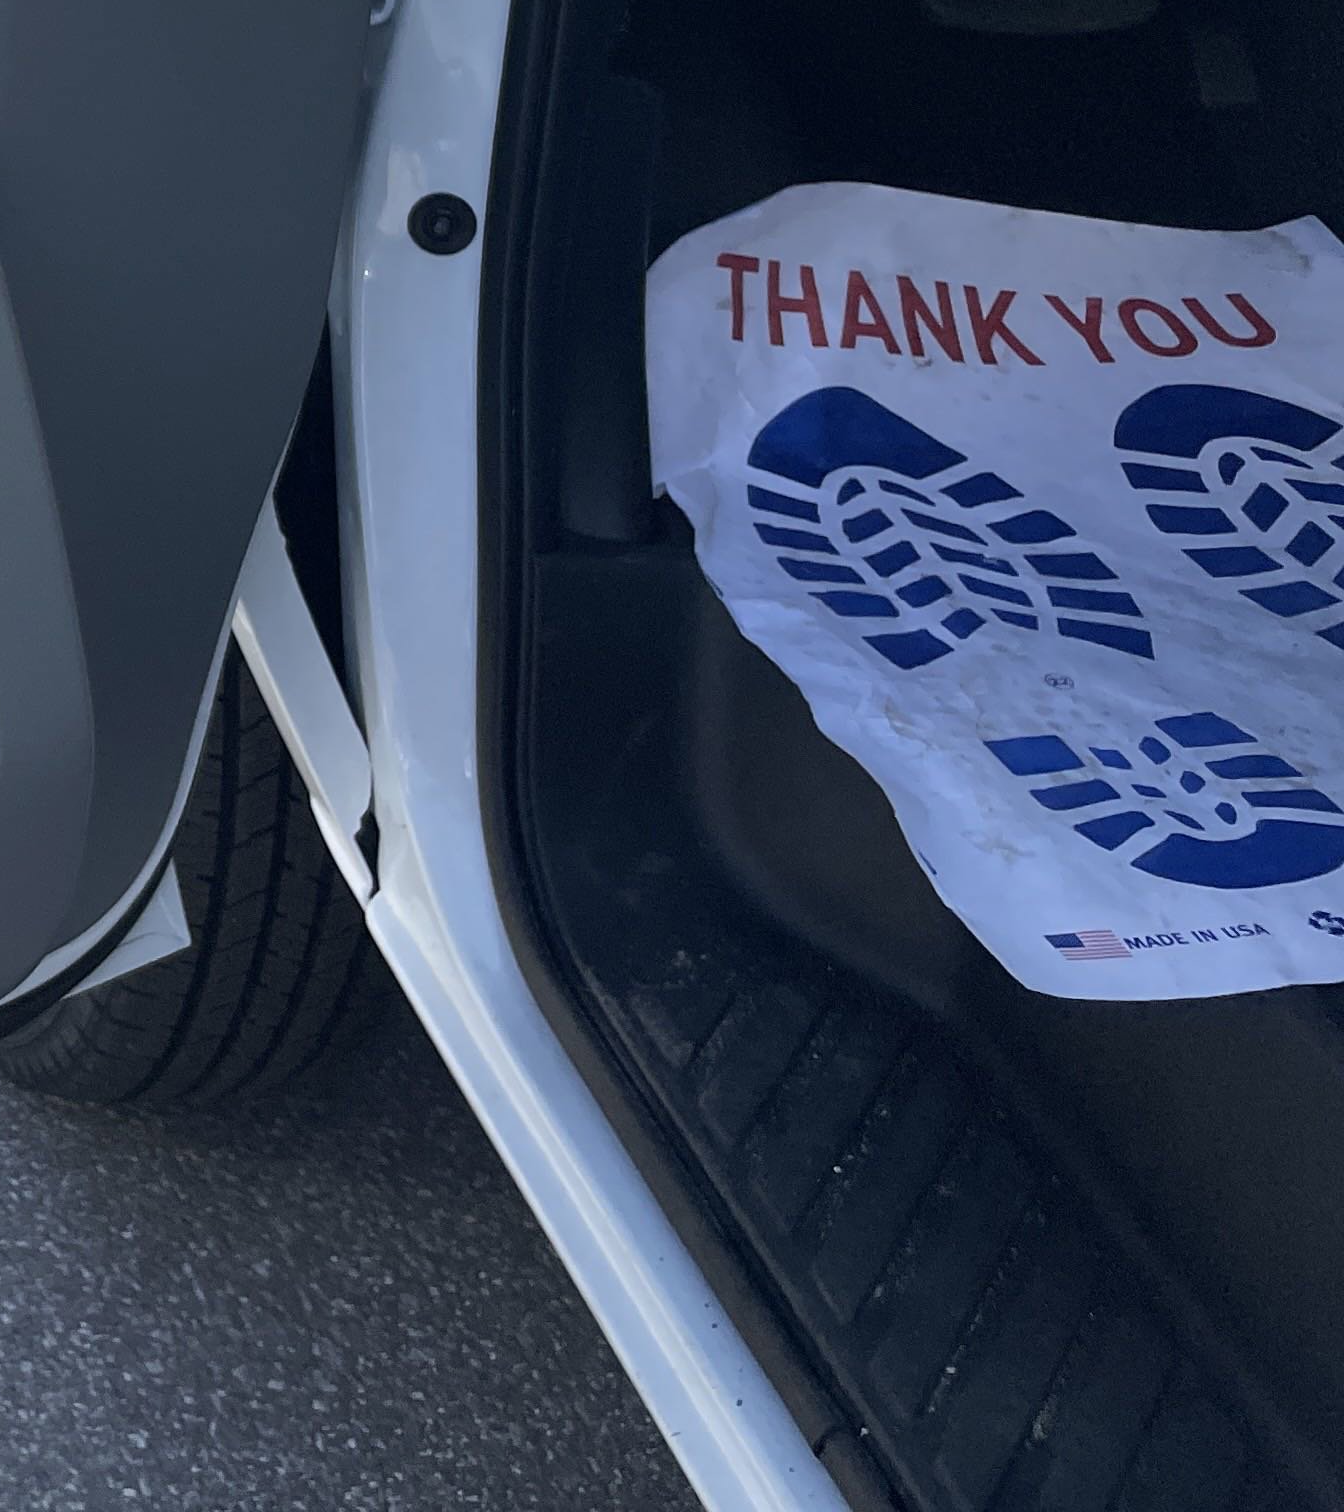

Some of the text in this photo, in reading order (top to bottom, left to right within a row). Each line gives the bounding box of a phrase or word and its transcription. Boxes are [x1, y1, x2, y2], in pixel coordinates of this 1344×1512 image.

[716, 253, 1276, 365] THANK YOU
[1124, 922, 1271, 950] MADE IN USA
